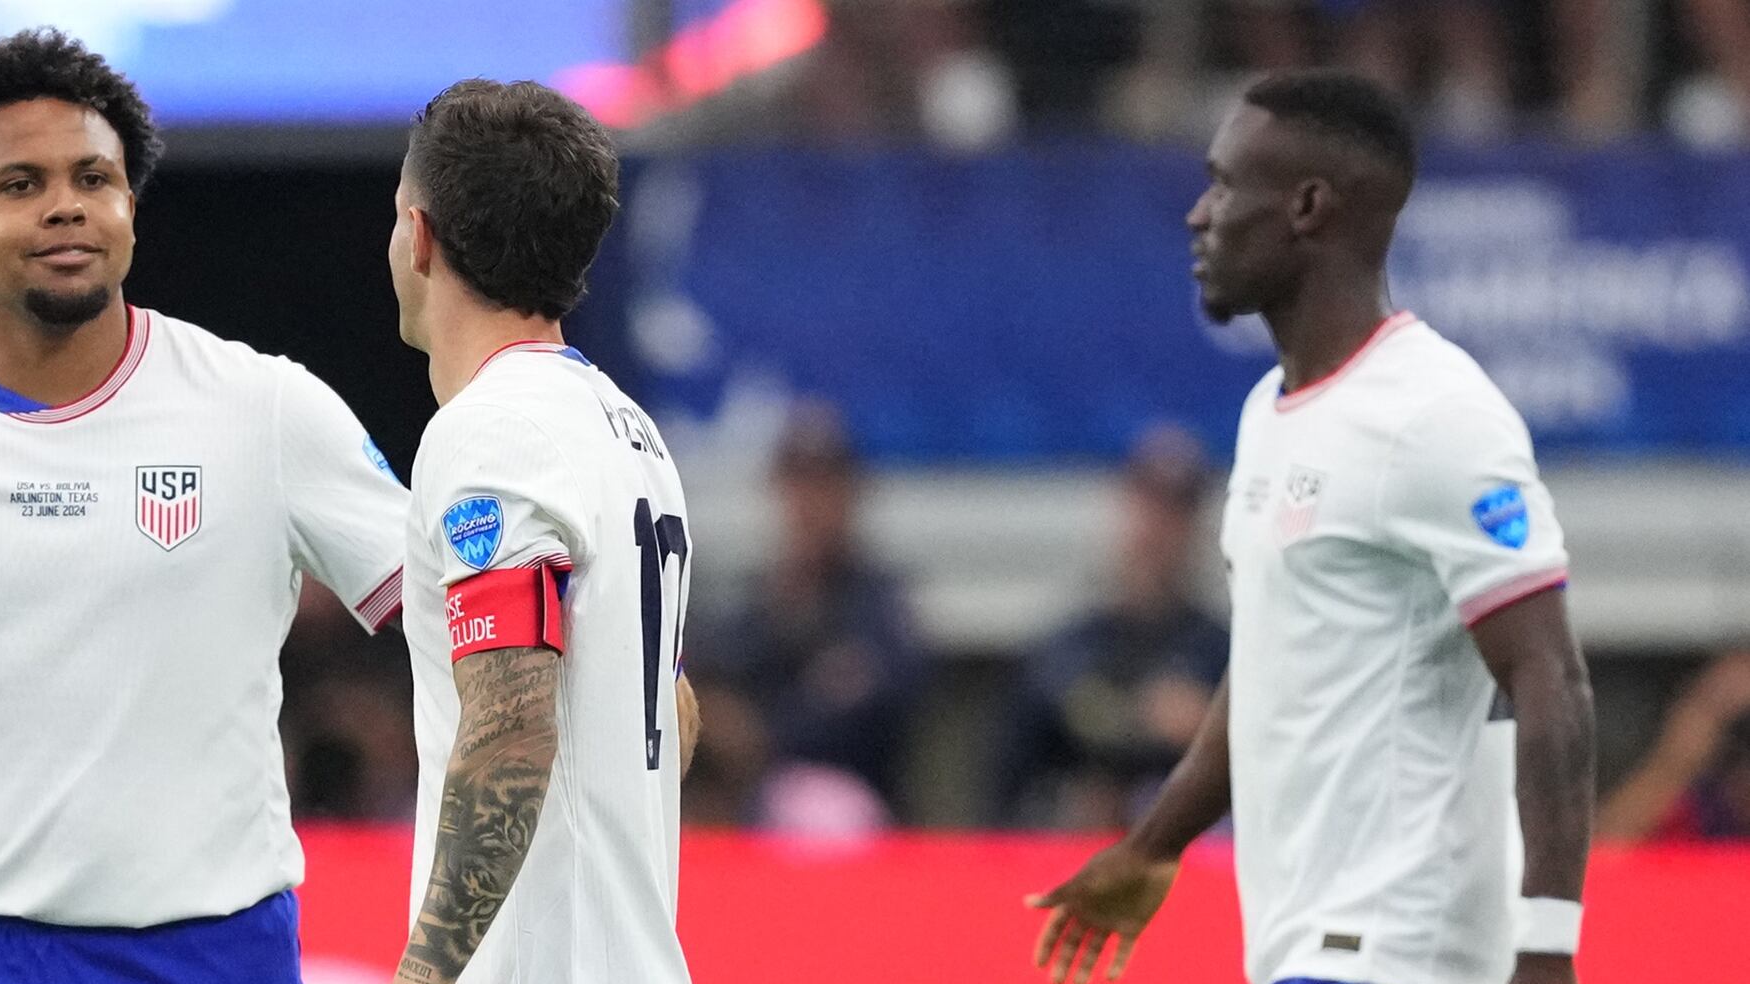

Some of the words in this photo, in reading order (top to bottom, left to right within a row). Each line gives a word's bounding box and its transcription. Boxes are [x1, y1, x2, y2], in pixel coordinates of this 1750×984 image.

[16, 482, 35, 490] USA
[56, 482, 91, 490] BOLIVIA
[142, 472, 197, 501] USA
[68, 493, 99, 502] TEXAS
[22, 505, 33, 516] 23
[37, 505, 59, 516] JUNE
[63, 505, 86, 516] 2024
[451, 513, 496, 535] ROCKING
